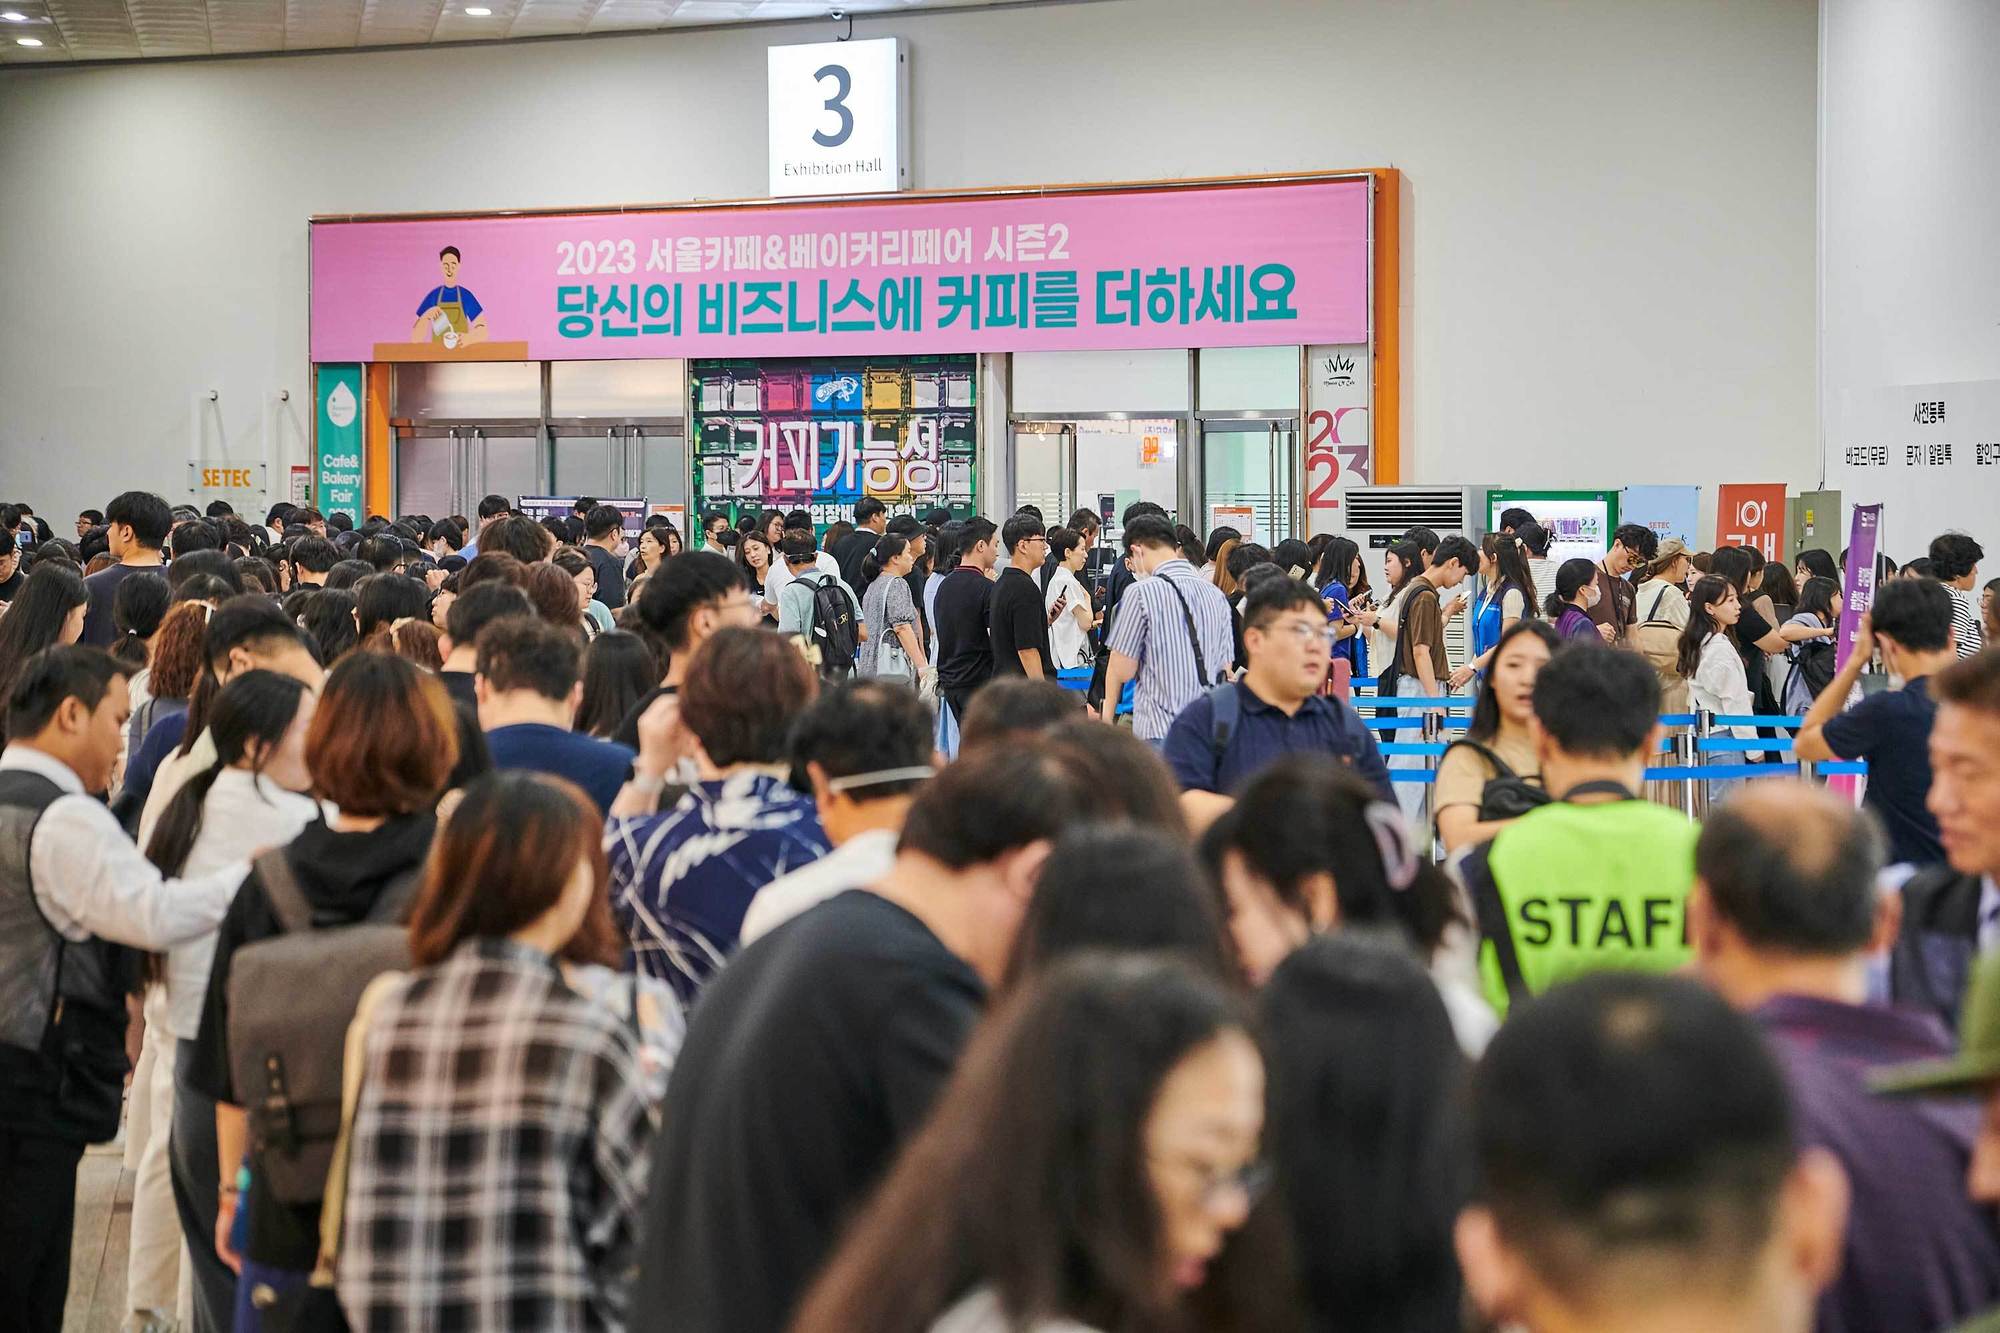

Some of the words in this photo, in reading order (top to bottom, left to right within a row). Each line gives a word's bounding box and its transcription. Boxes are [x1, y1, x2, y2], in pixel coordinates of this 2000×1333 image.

[812, 64, 854, 147] 3
[784, 160, 851, 176] Exhibition
[855, 157, 882, 172] Hall
[557, 239, 636, 275] 2023
[646, 227, 972, 274] 서울카페&베이커리페어
[984, 223, 1069, 262] 시즌2
[557, 283, 682, 338] 당신의
[699, 276, 922, 335] 비즈니스에
[938, 270, 1079, 330] 커피를
[1096, 263, 1298, 326] 더하세요
[1913, 401, 1945, 424] 사전등록
[323, 454, 358, 467] Cafe&
[738, 418, 939, 491] 커피가능성
[1846, 446, 1888, 466] 바코드(무료)
[1906, 445, 1921, 466] 문자
[1929, 444, 1952, 465] 알림톡
[202, 468, 251, 487] SETEC
[322, 471, 361, 488] Bakery
[330, 489, 353, 502] Fair
[1648, 521, 1670, 530] SETEC
[1520, 896, 1688, 947] STAF
